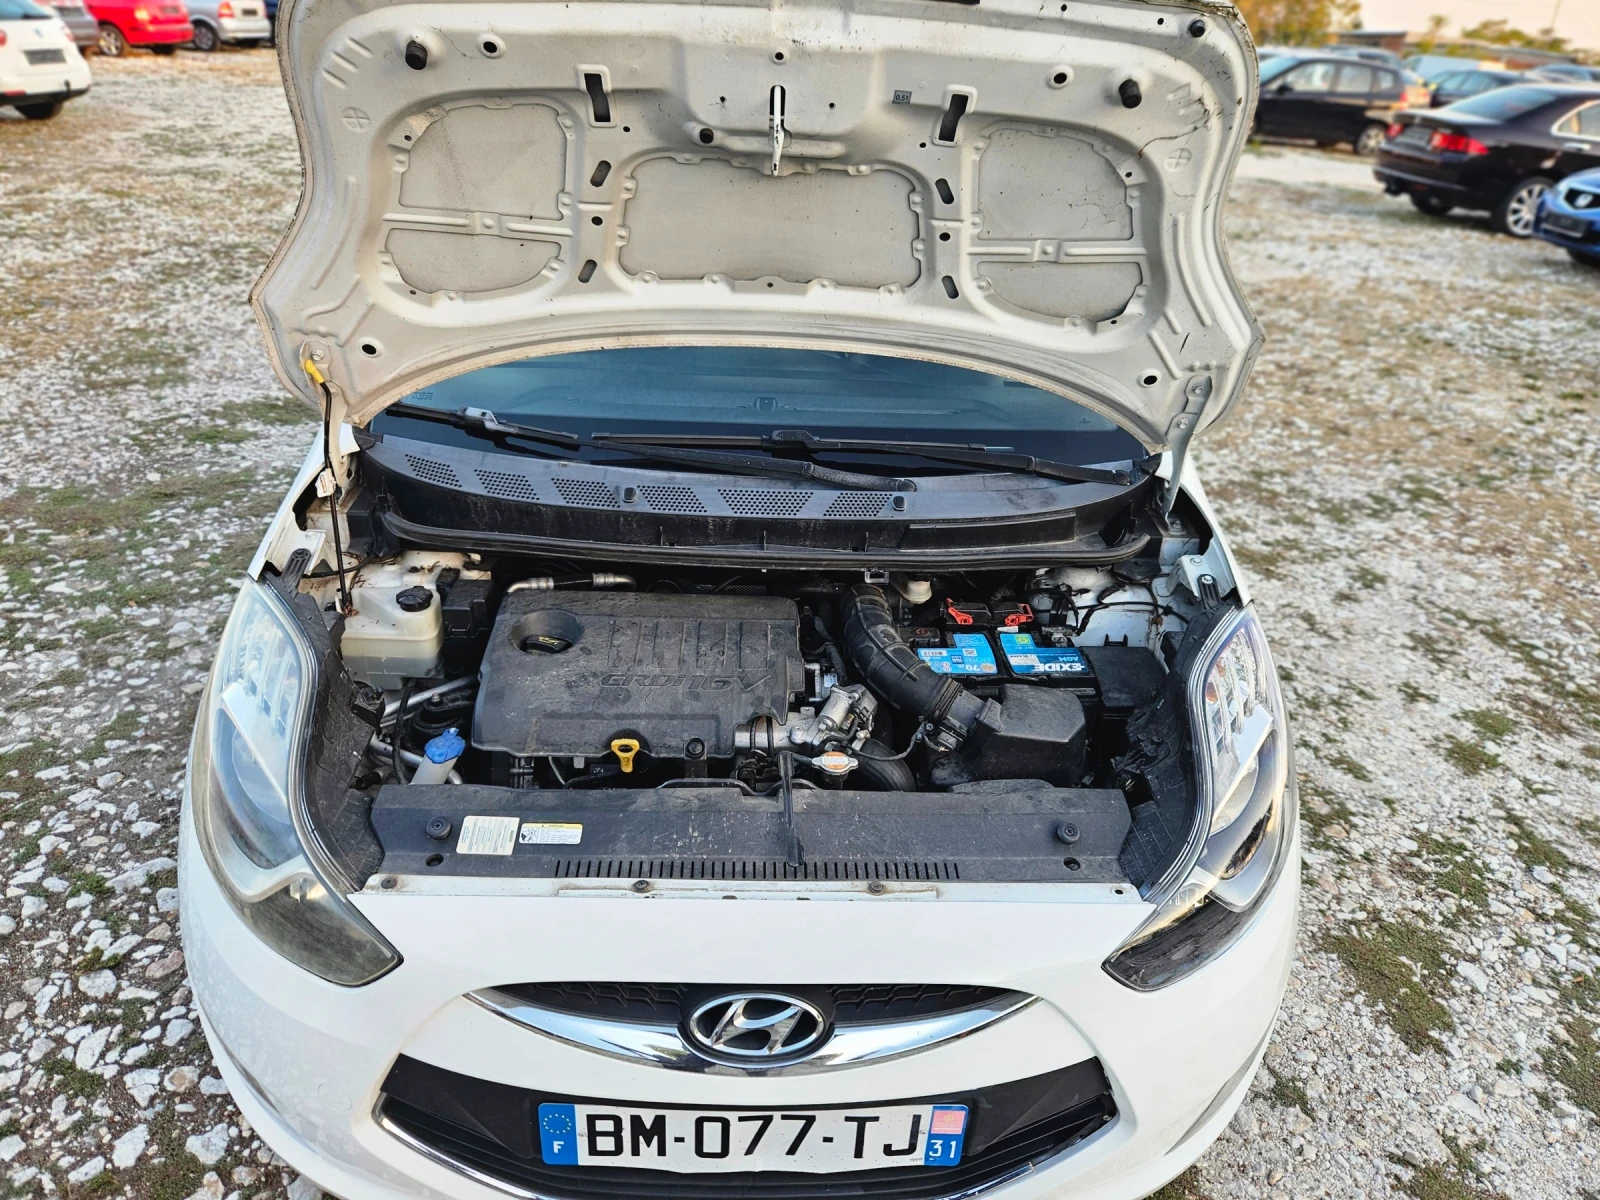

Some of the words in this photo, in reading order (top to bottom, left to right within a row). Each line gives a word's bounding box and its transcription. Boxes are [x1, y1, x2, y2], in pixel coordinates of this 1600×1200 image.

[965, 664, 981, 672] 70
[1034, 663, 1085, 672] EXIDE
[586, 1114, 922, 1159] BM-077-TJ
[553, 1141, 565, 1154] F
[929, 1139, 957, 1159] 31
